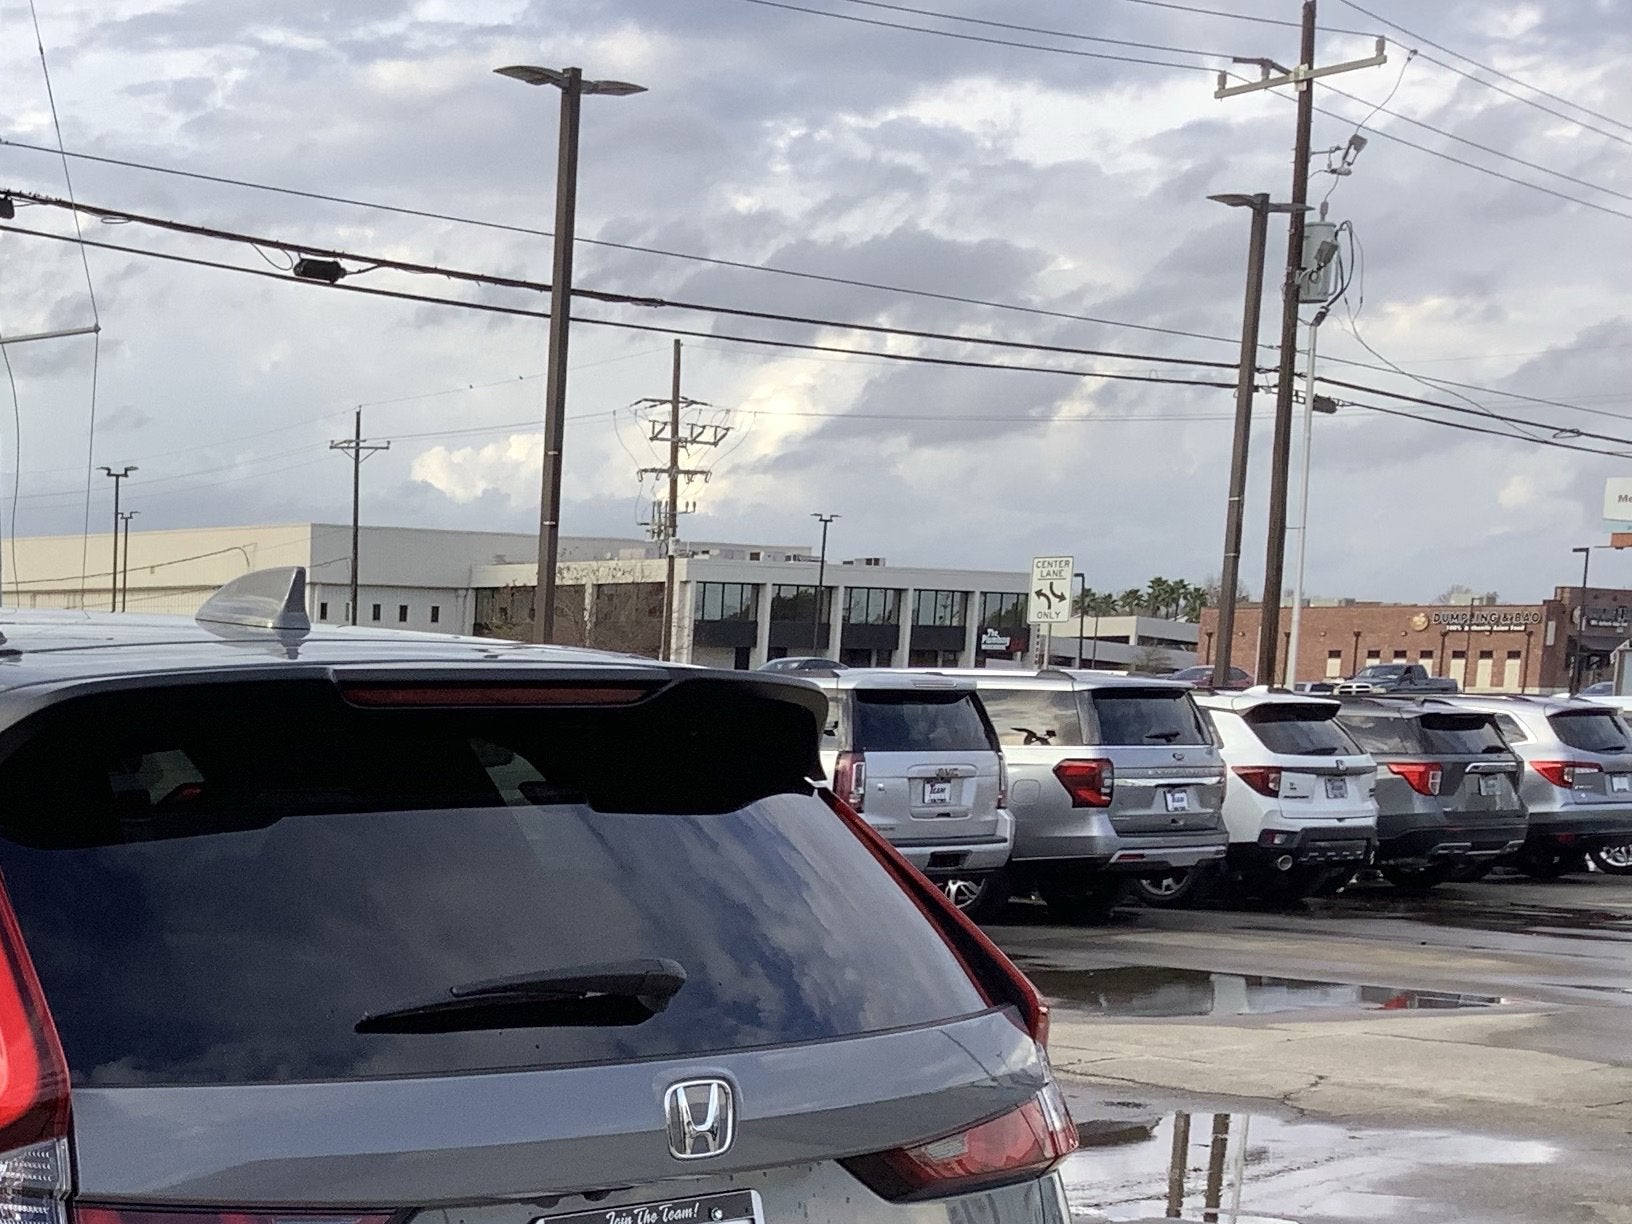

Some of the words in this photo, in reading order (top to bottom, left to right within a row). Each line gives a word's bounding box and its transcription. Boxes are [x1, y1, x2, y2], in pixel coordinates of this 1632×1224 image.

[1035, 559, 1070, 569] CENTER
[1040, 569, 1064, 578] LANE
[1037, 611, 1061, 619] ONLY
[1500, 612, 1514, 624] &
[1514, 611, 1542, 625] BAO
[634, 1206, 658, 1224] The
[658, 1202, 700, 1222] Team!
